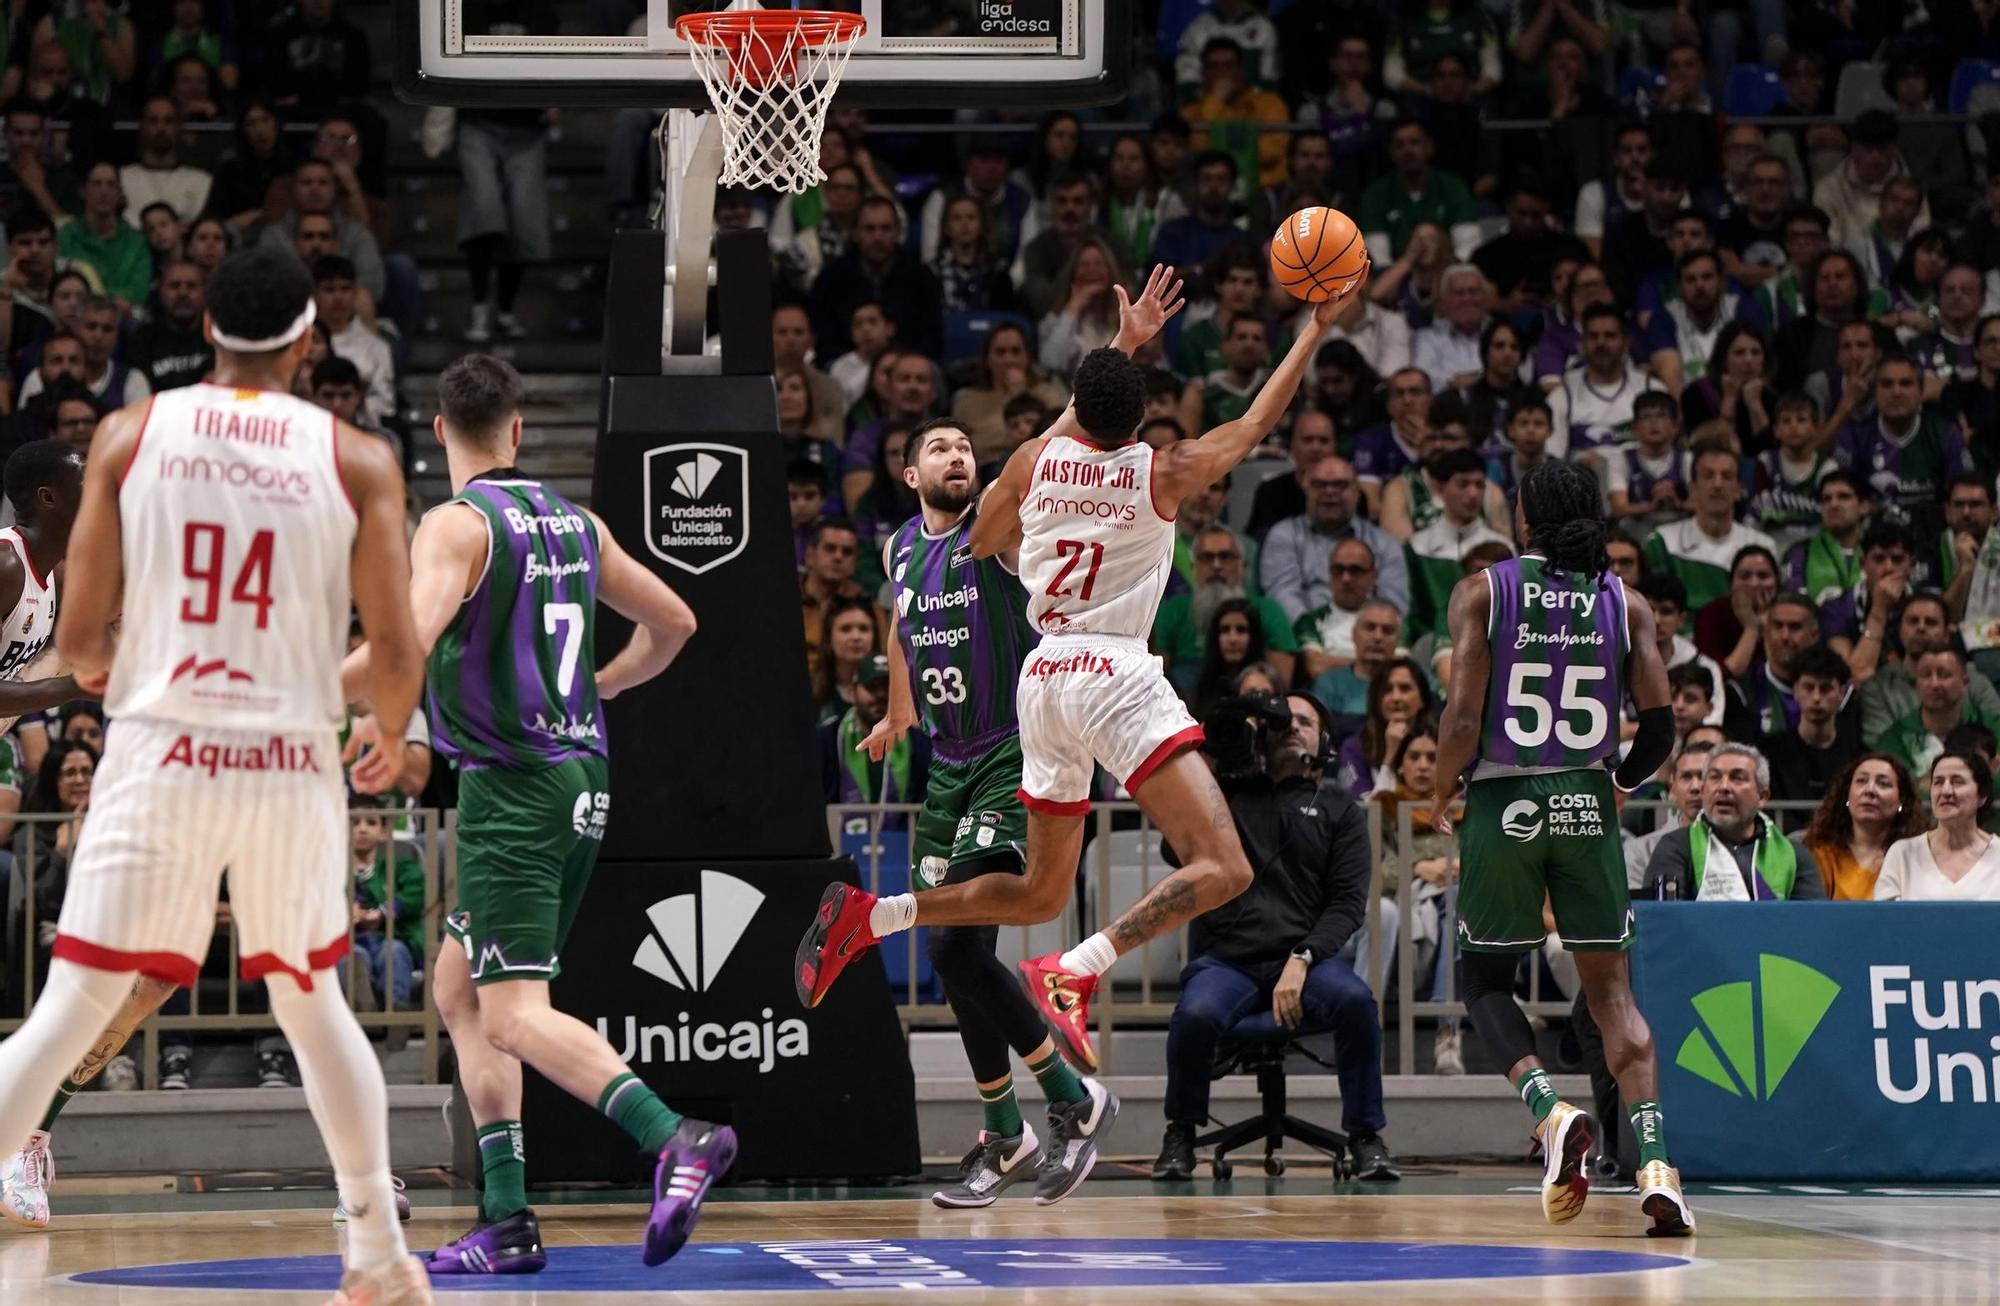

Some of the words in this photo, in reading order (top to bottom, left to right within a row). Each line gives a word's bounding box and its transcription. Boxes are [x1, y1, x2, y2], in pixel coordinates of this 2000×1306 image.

[981, 0, 1012, 18] liga
[981, 16, 1050, 32] endesa
[193, 407, 294, 448] TRAORÉ
[1041, 459, 1106, 488] ALSTON
[1111, 466, 1141, 491] JR.
[661, 504, 732, 518] Fundación
[1037, 491, 1136, 521] inmoovs
[661, 534, 733, 546] Baloncesto
[672, 520, 723, 536] Unicaja
[180, 521, 275, 631] 94
[1045, 538, 1105, 601] 21
[917, 585, 979, 613] Unicaja
[1523, 582, 1596, 618] Perry
[543, 602, 585, 697] 7
[922, 666, 967, 706] 33
[1504, 662, 1608, 750] 55
[1548, 794, 1600, 809] COSTA
[1549, 811, 1577, 823] DEL
[1580, 811, 1602, 823] SOL
[1549, 824, 1604, 836] MÁLAGA
[1869, 965, 2000, 1030] Fun
[596, 1007, 809, 1073] Unicaja
[1641, 1110, 1657, 1144] UNICAJA
